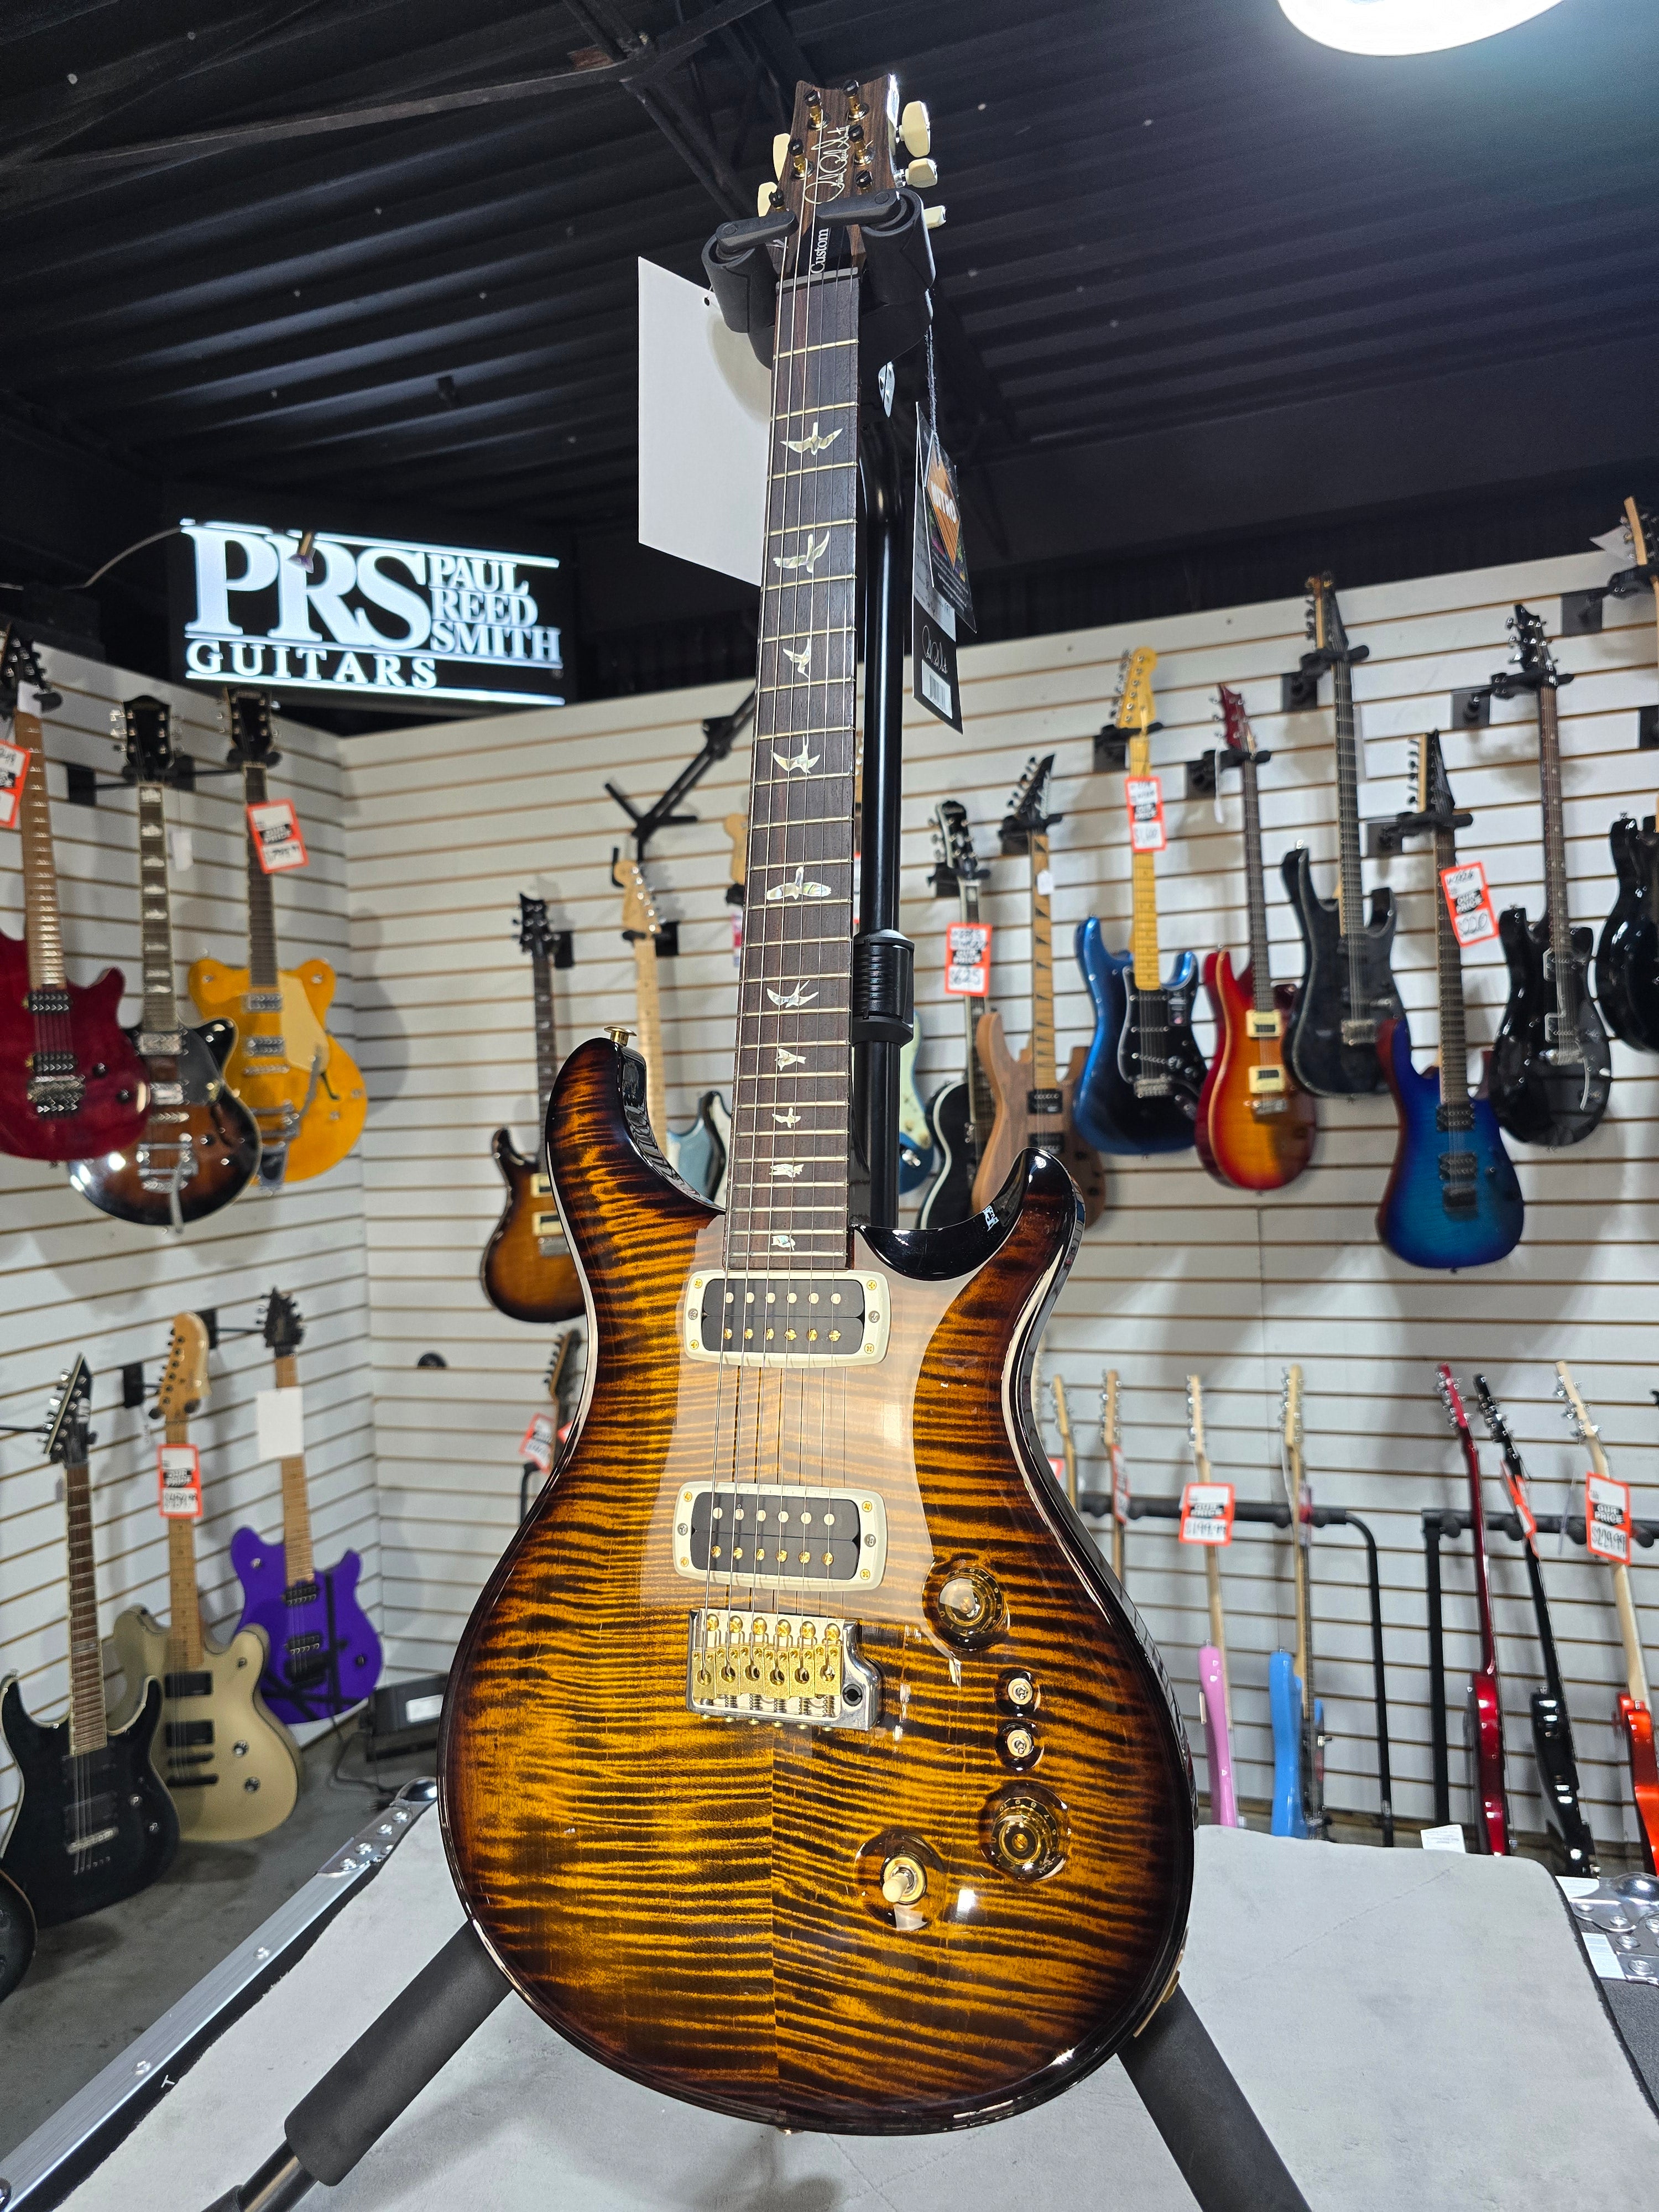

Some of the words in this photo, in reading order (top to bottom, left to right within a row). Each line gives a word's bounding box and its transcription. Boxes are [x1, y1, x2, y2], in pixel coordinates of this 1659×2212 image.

[810, 227, 829, 274] Custom
[180, 526, 431, 651] PRS
[427, 552, 529, 596] PAUL
[429, 586, 539, 627] REED
[430, 620, 563, 664] SMITH
[186, 639, 437, 690] GUITARS
[1594, 1511, 1624, 1525] PRICE
[1597, 1504, 1617, 1515] OUR
